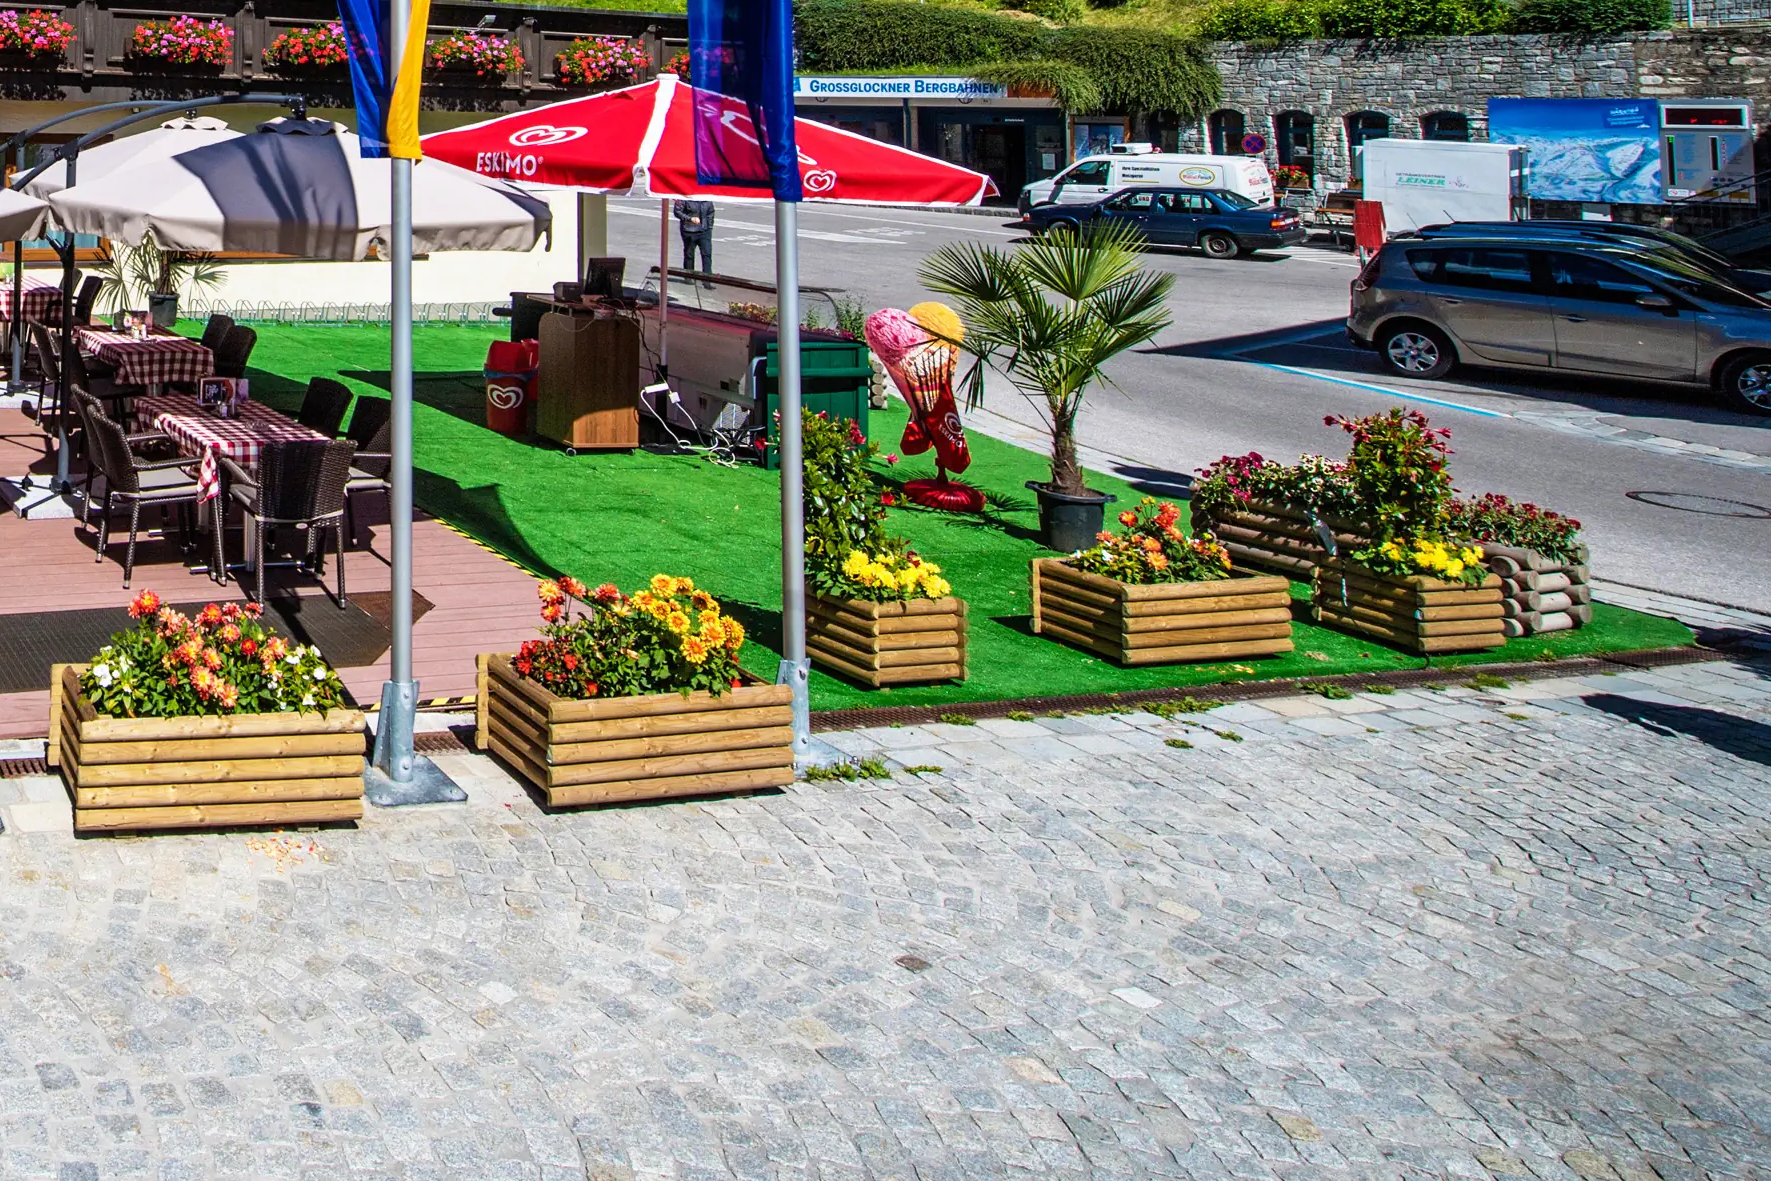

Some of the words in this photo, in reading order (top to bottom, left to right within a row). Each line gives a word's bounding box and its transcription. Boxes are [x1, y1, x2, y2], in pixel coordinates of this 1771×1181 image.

[809, 79, 911, 93] GROSSGLOCKNER
[914, 78, 998, 94] BERGBAHNEN
[476, 152, 538, 176] ESKIMO
[1397, 176, 1446, 185] LEINER
